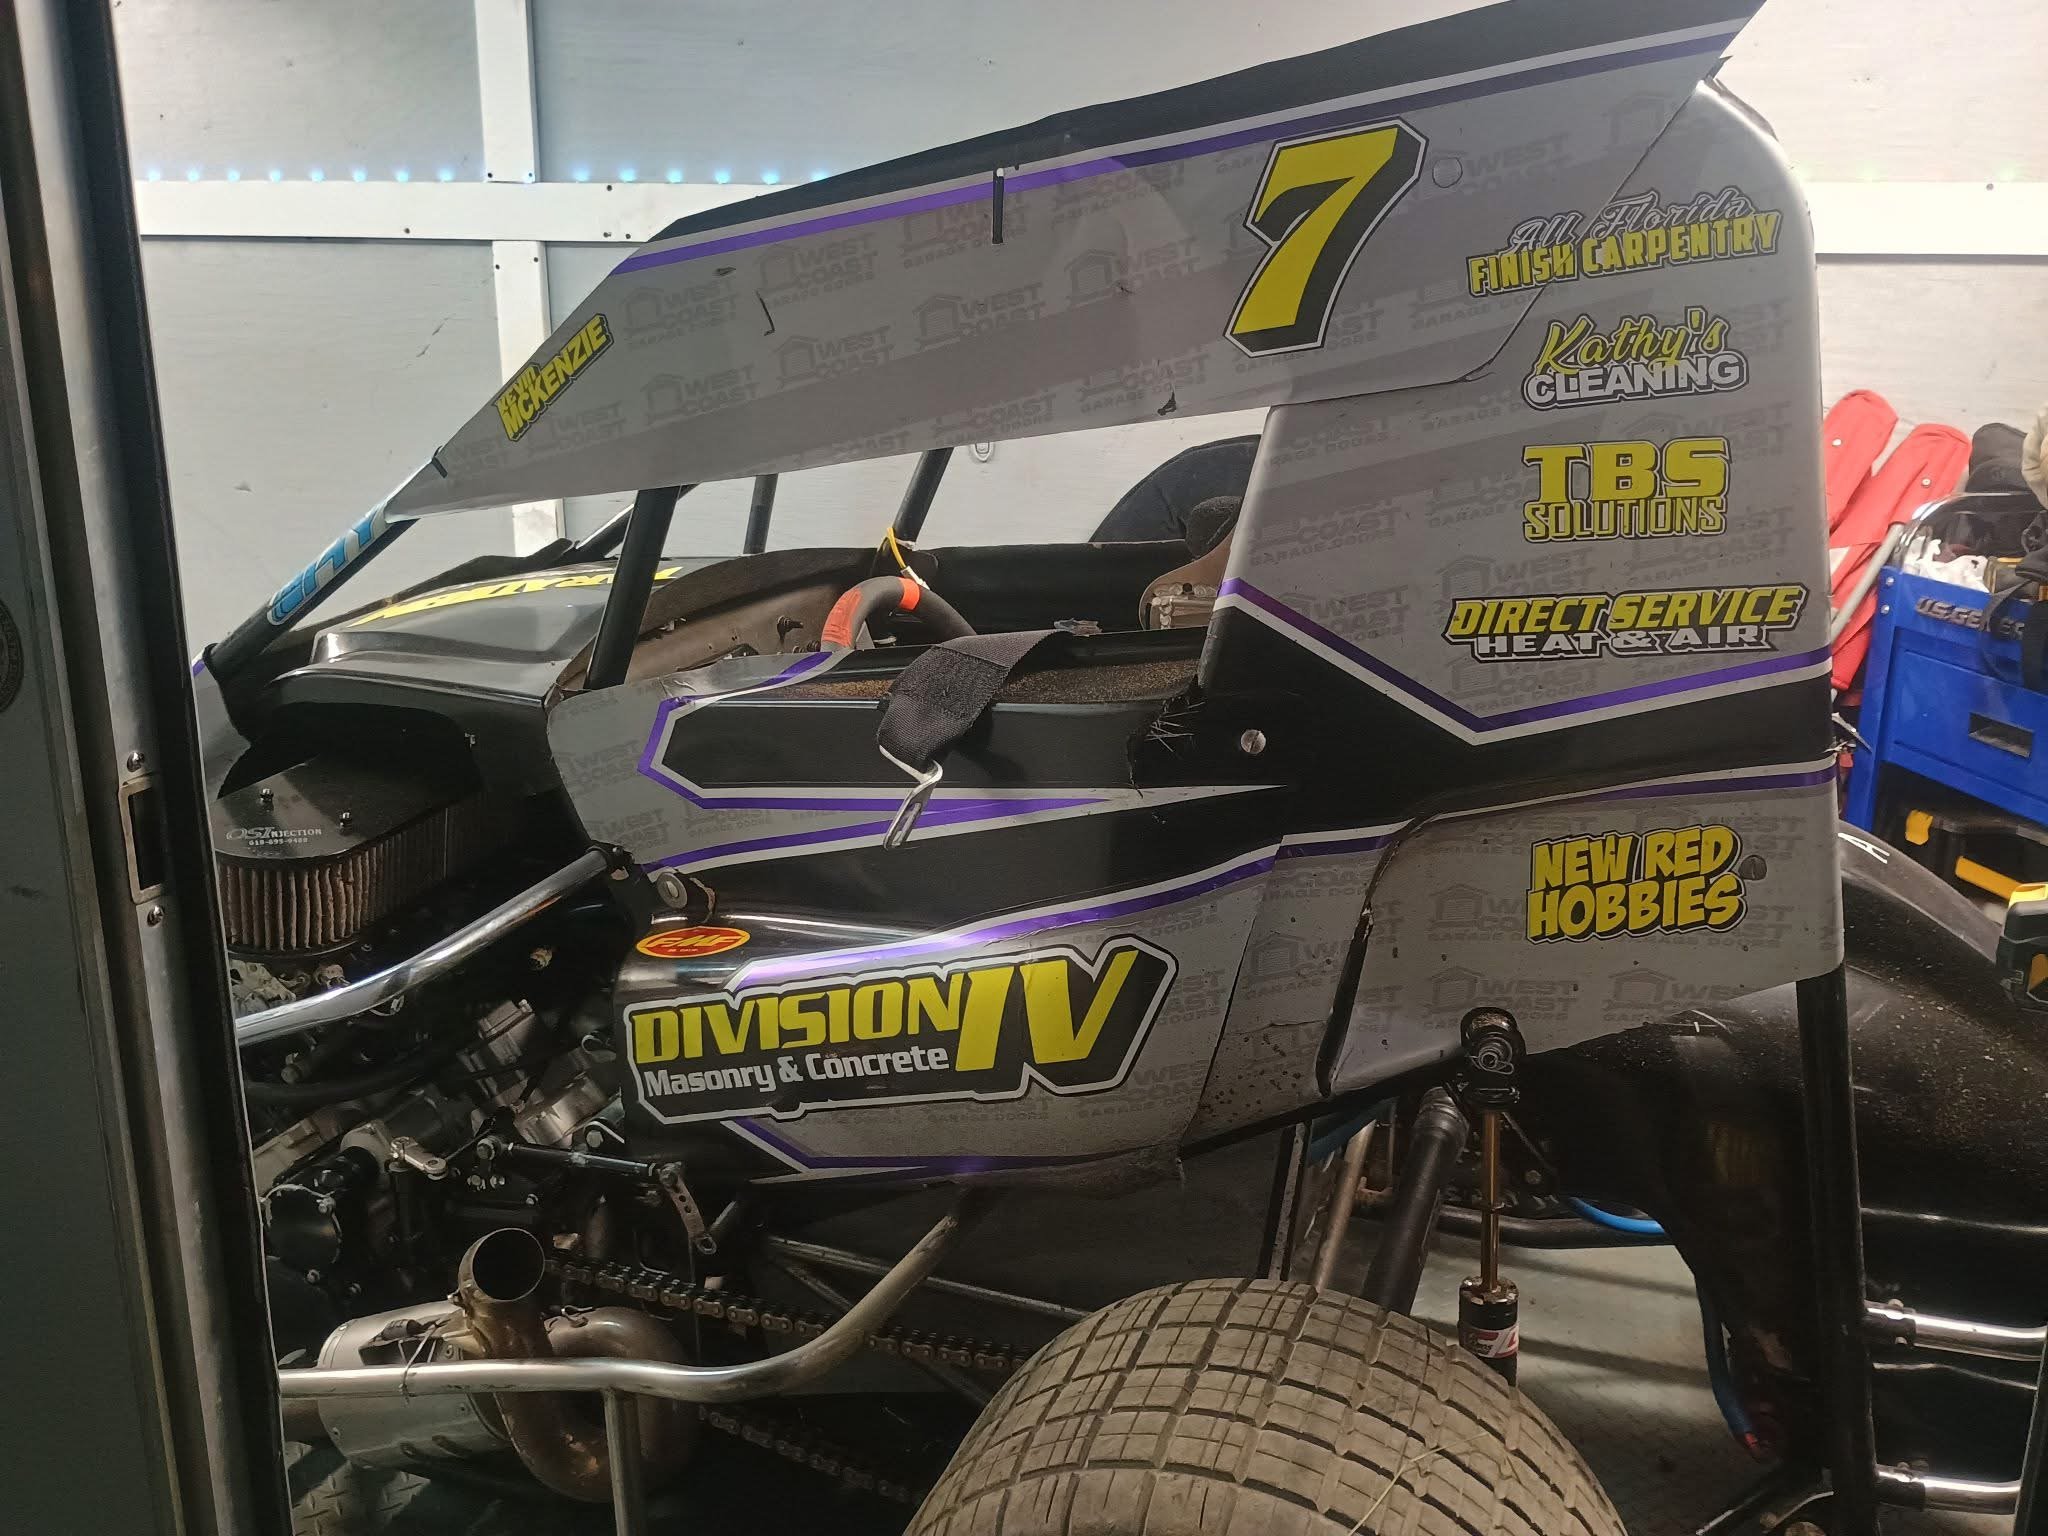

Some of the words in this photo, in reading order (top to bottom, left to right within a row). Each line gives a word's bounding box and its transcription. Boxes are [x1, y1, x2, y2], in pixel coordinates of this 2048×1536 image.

[1228, 122, 1414, 346] 7
[1510, 214, 1578, 252] All
[1592, 189, 1753, 238] Florida
[1470, 243, 1578, 294] FINISH
[1582, 212, 1779, 272] CARPENTRY
[1535, 309, 1728, 375] Kathy's
[1527, 354, 1741, 404] CLEANING
[1524, 441, 1727, 501] TBS
[1524, 499, 1725, 539] SOLUTIONS
[1450, 598, 1610, 635] DIRECT
[1609, 588, 1803, 630] SERVICE
[1478, 633, 1600, 656] HEAT
[1611, 630, 1654, 652] &
[1666, 625, 1765, 649] AIR
[1533, 834, 1634, 890] NEW
[1643, 825, 1736, 880] RED
[1528, 874, 1743, 939] HOBBIES
[645, 933, 743, 949] FMF
[632, 971, 968, 1064] DIVISION
[955, 949, 1140, 1073] IV
[643, 1063, 777, 1097] Masonry
[777, 1055, 804, 1084] &
[804, 1046, 951, 1080] Concrete
